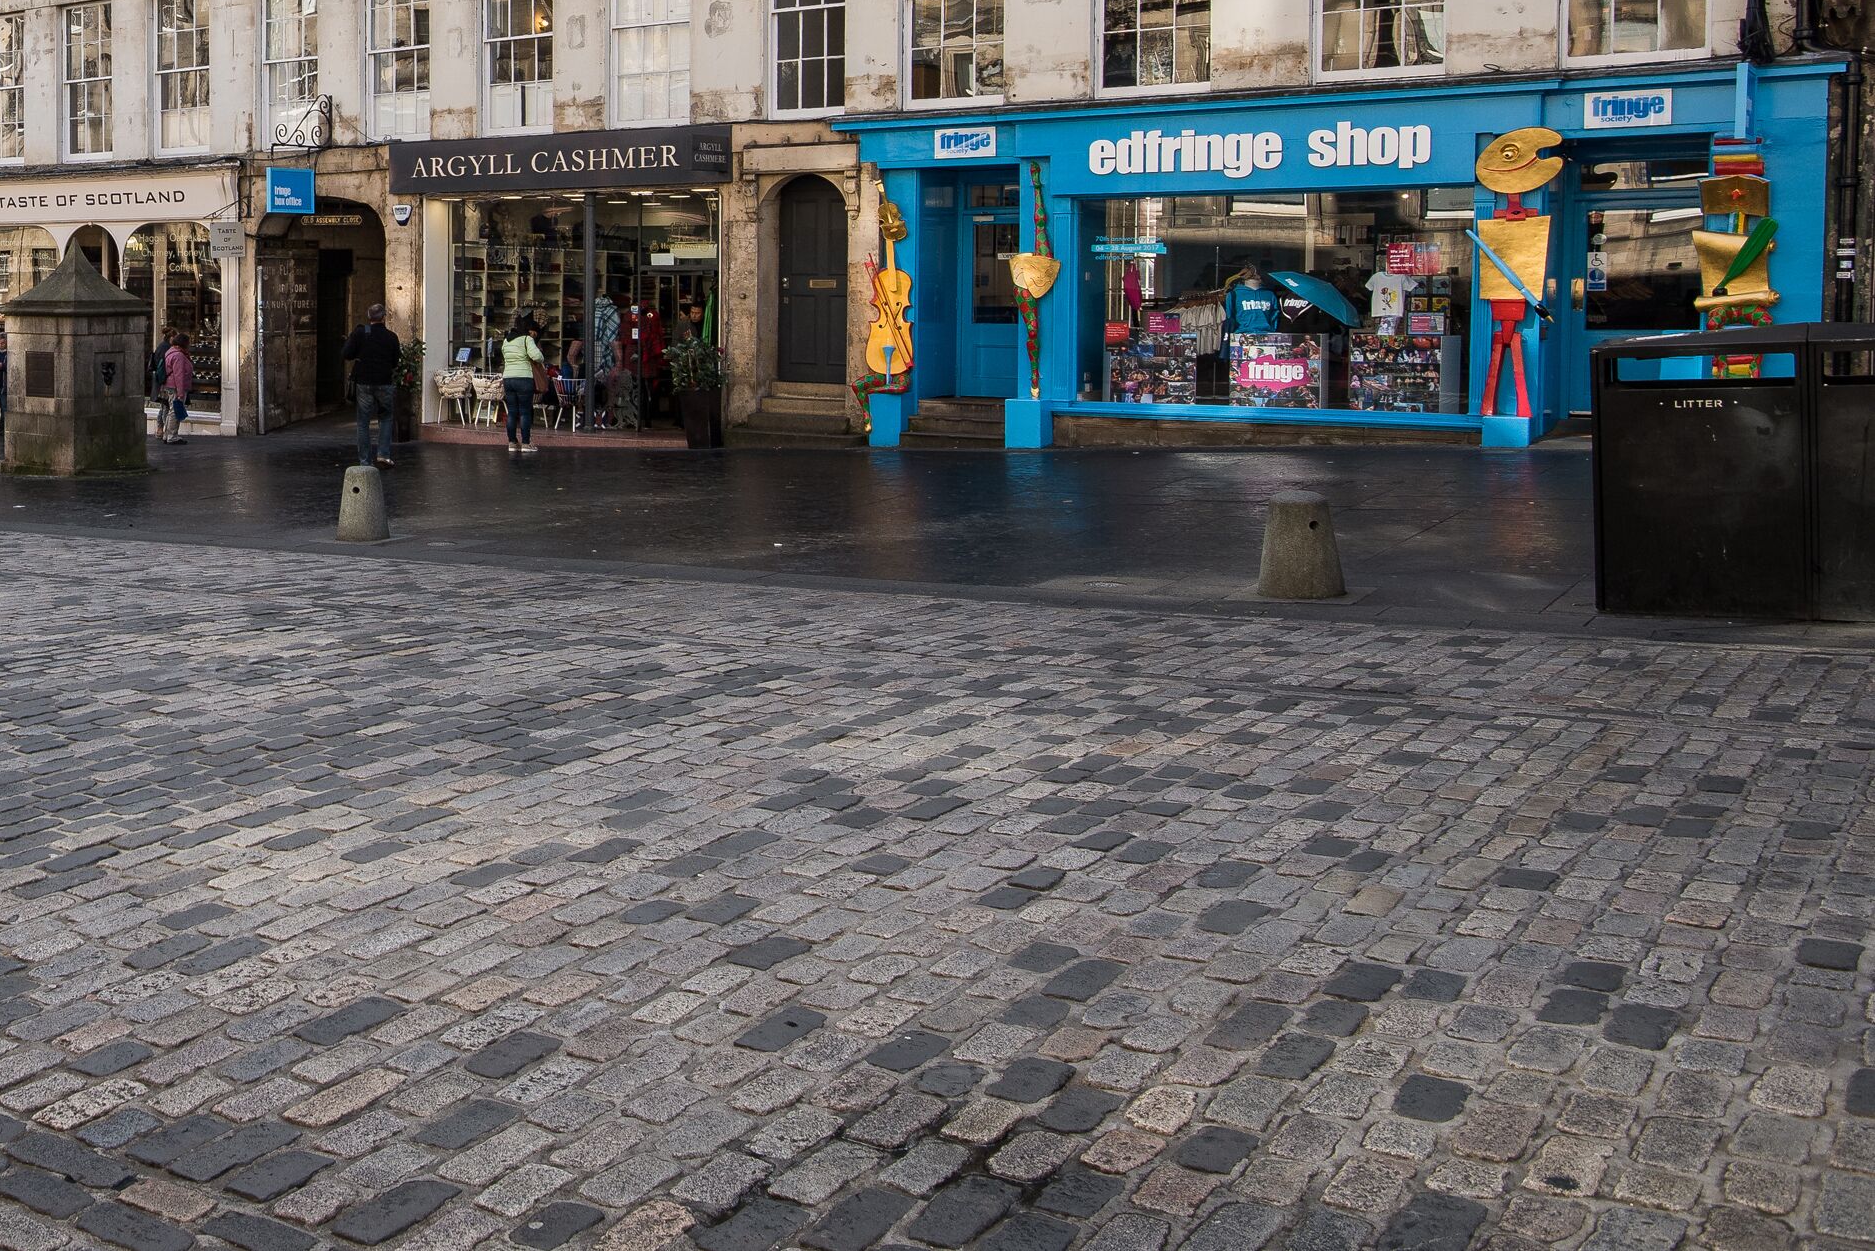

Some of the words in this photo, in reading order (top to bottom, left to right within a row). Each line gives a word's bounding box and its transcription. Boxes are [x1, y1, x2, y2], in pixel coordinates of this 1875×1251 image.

[1592, 96, 1664, 118] fringe
[1601, 115, 1632, 123] society
[699, 141, 723, 151] ARGYLL
[940, 132, 990, 150] fringe
[1089, 129, 1282, 178] edfringe
[1308, 121, 1431, 168] shop
[411, 153, 521, 178] ARGYLL
[530, 145, 680, 173] CASHMER
[694, 152, 726, 164] CASHMERE
[275, 186, 291, 197] fringe
[56, 195, 77, 207] OF
[85, 191, 185, 206] SCOTLAND
[275, 196, 285, 206] box
[286, 196, 302, 206] office
[316, 216, 341, 224] ASSEMBLY
[1284, 299, 1308, 308] fringe
[1248, 362, 1304, 382] fringe
[1674, 400, 1723, 408] LITTER
